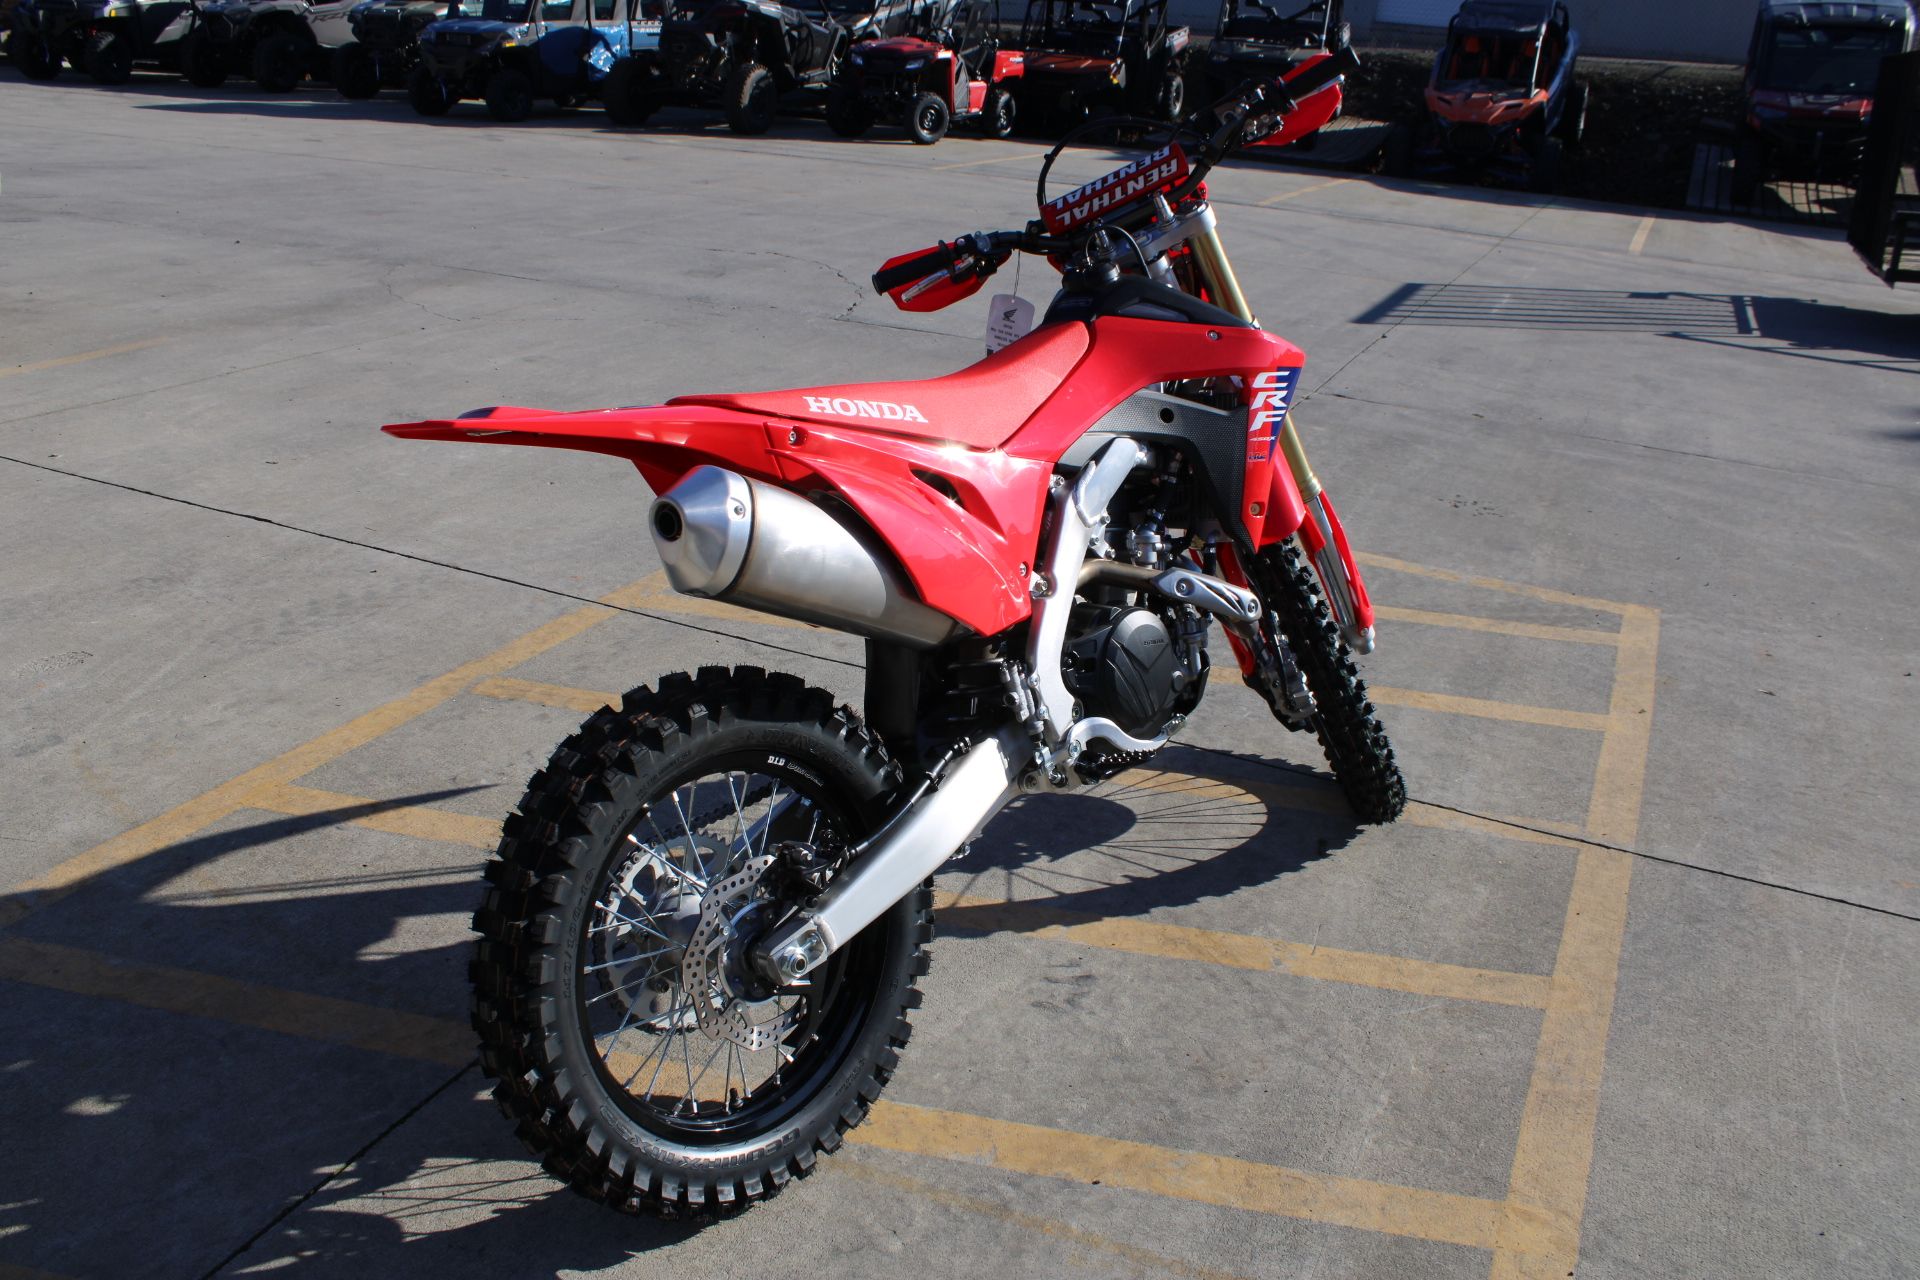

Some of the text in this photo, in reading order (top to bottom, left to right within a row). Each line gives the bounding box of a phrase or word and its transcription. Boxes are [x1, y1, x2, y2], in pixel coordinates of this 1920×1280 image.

[1049, 145, 1171, 211] RENTHAL
[1056, 158, 1178, 226] RENTHAL
[802, 396, 929, 423] HONDA
[1249, 371, 1290, 432] CRF
